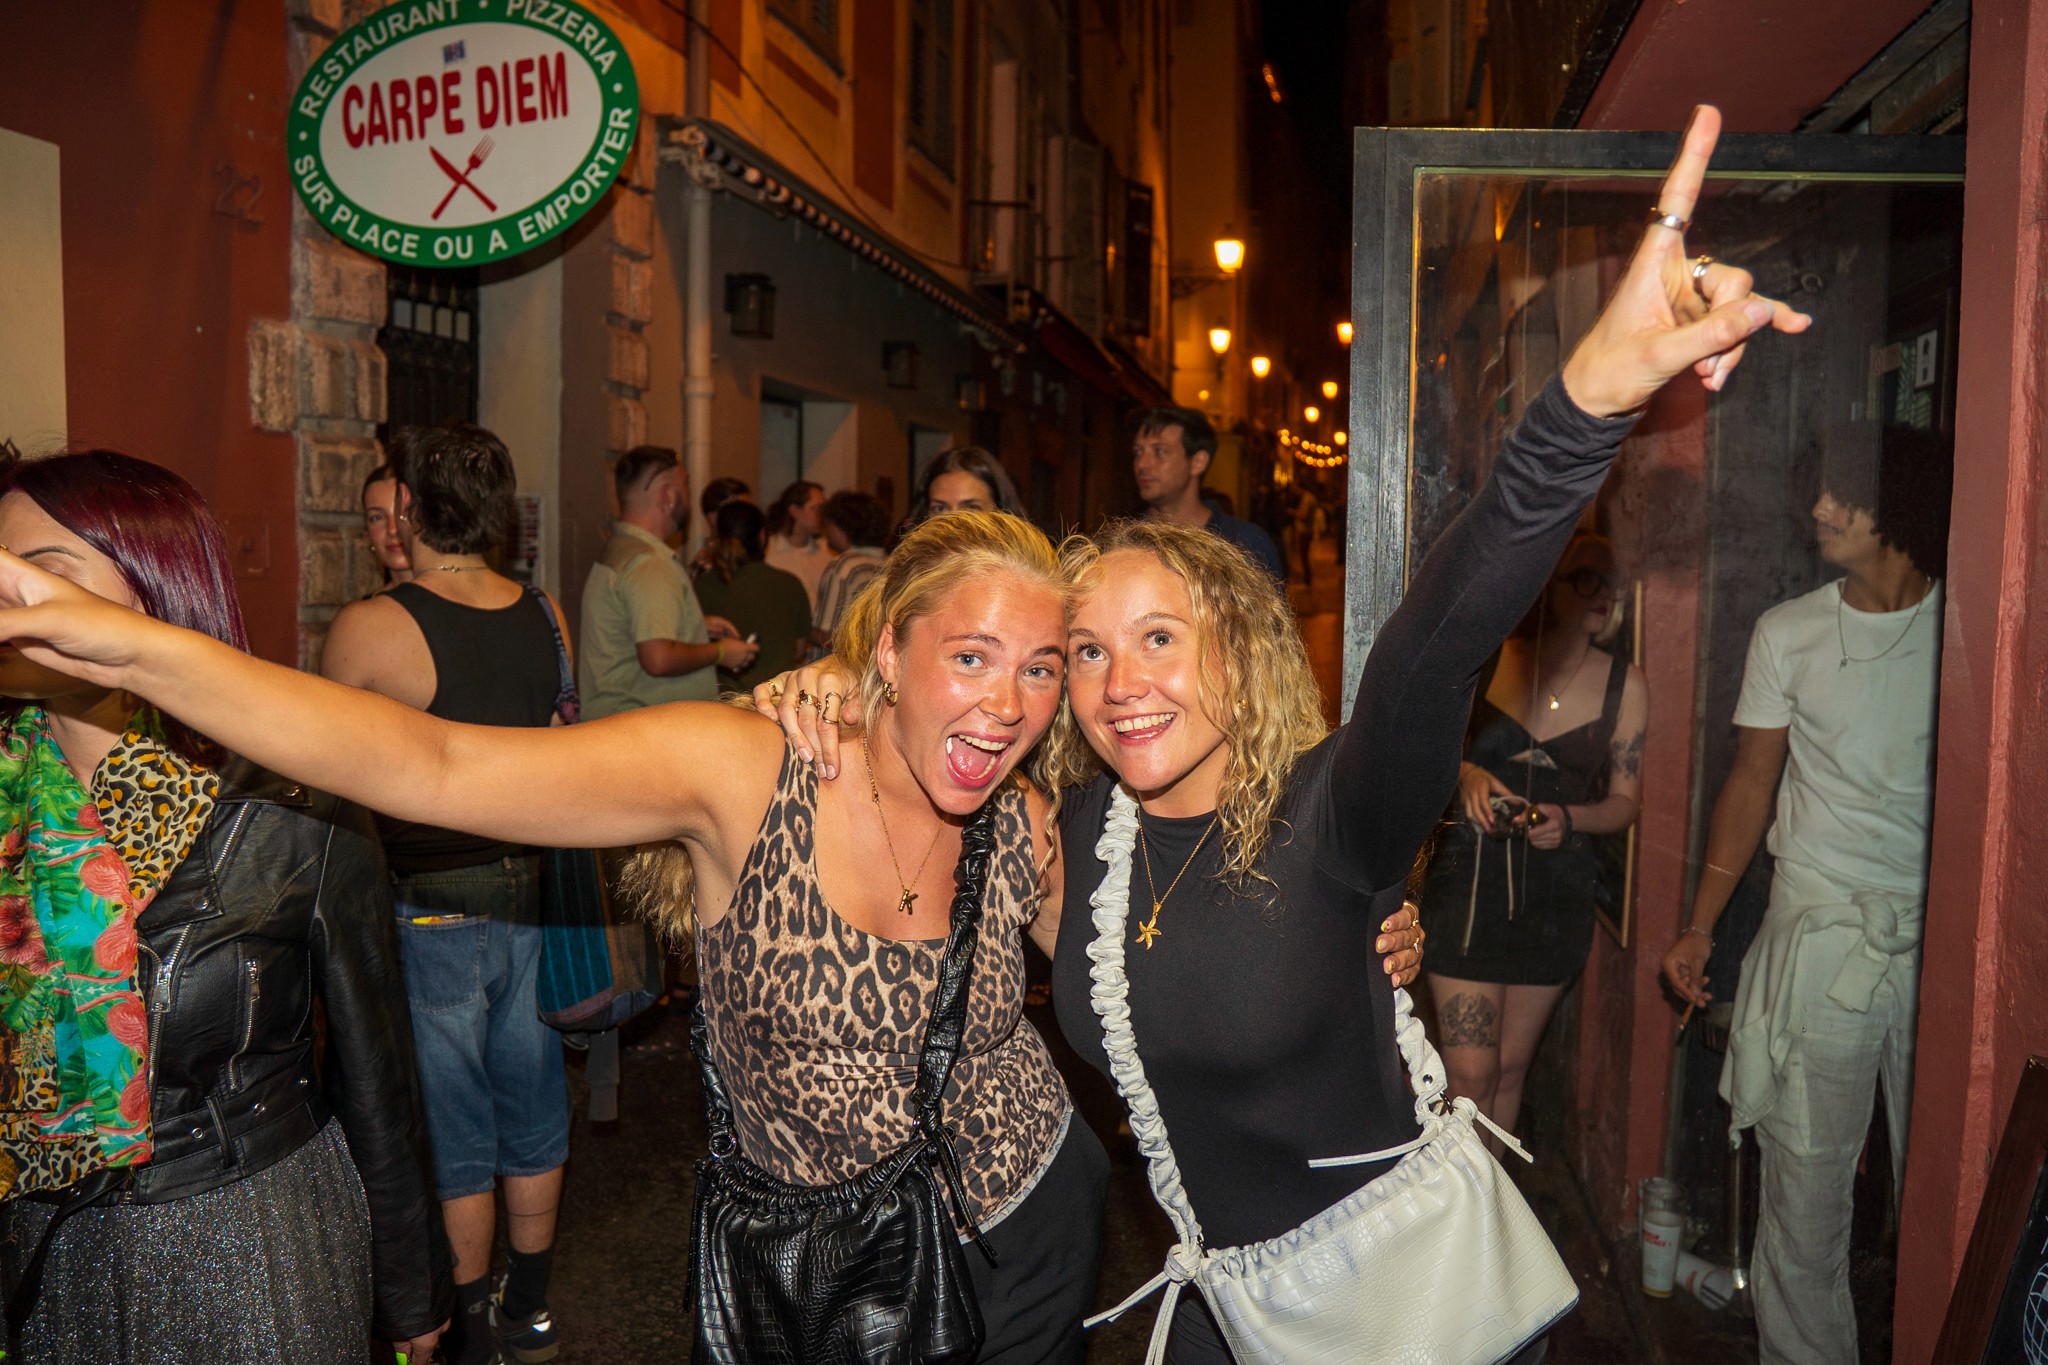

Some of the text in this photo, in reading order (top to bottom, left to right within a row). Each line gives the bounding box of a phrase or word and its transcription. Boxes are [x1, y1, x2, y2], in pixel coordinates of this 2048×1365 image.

[299, 0, 617, 119] RESTAURANT PIZZERIA
[342, 51, 568, 149] CARPE DIEM
[294, 107, 633, 260] SUR PLACE OU A EMPORTER
